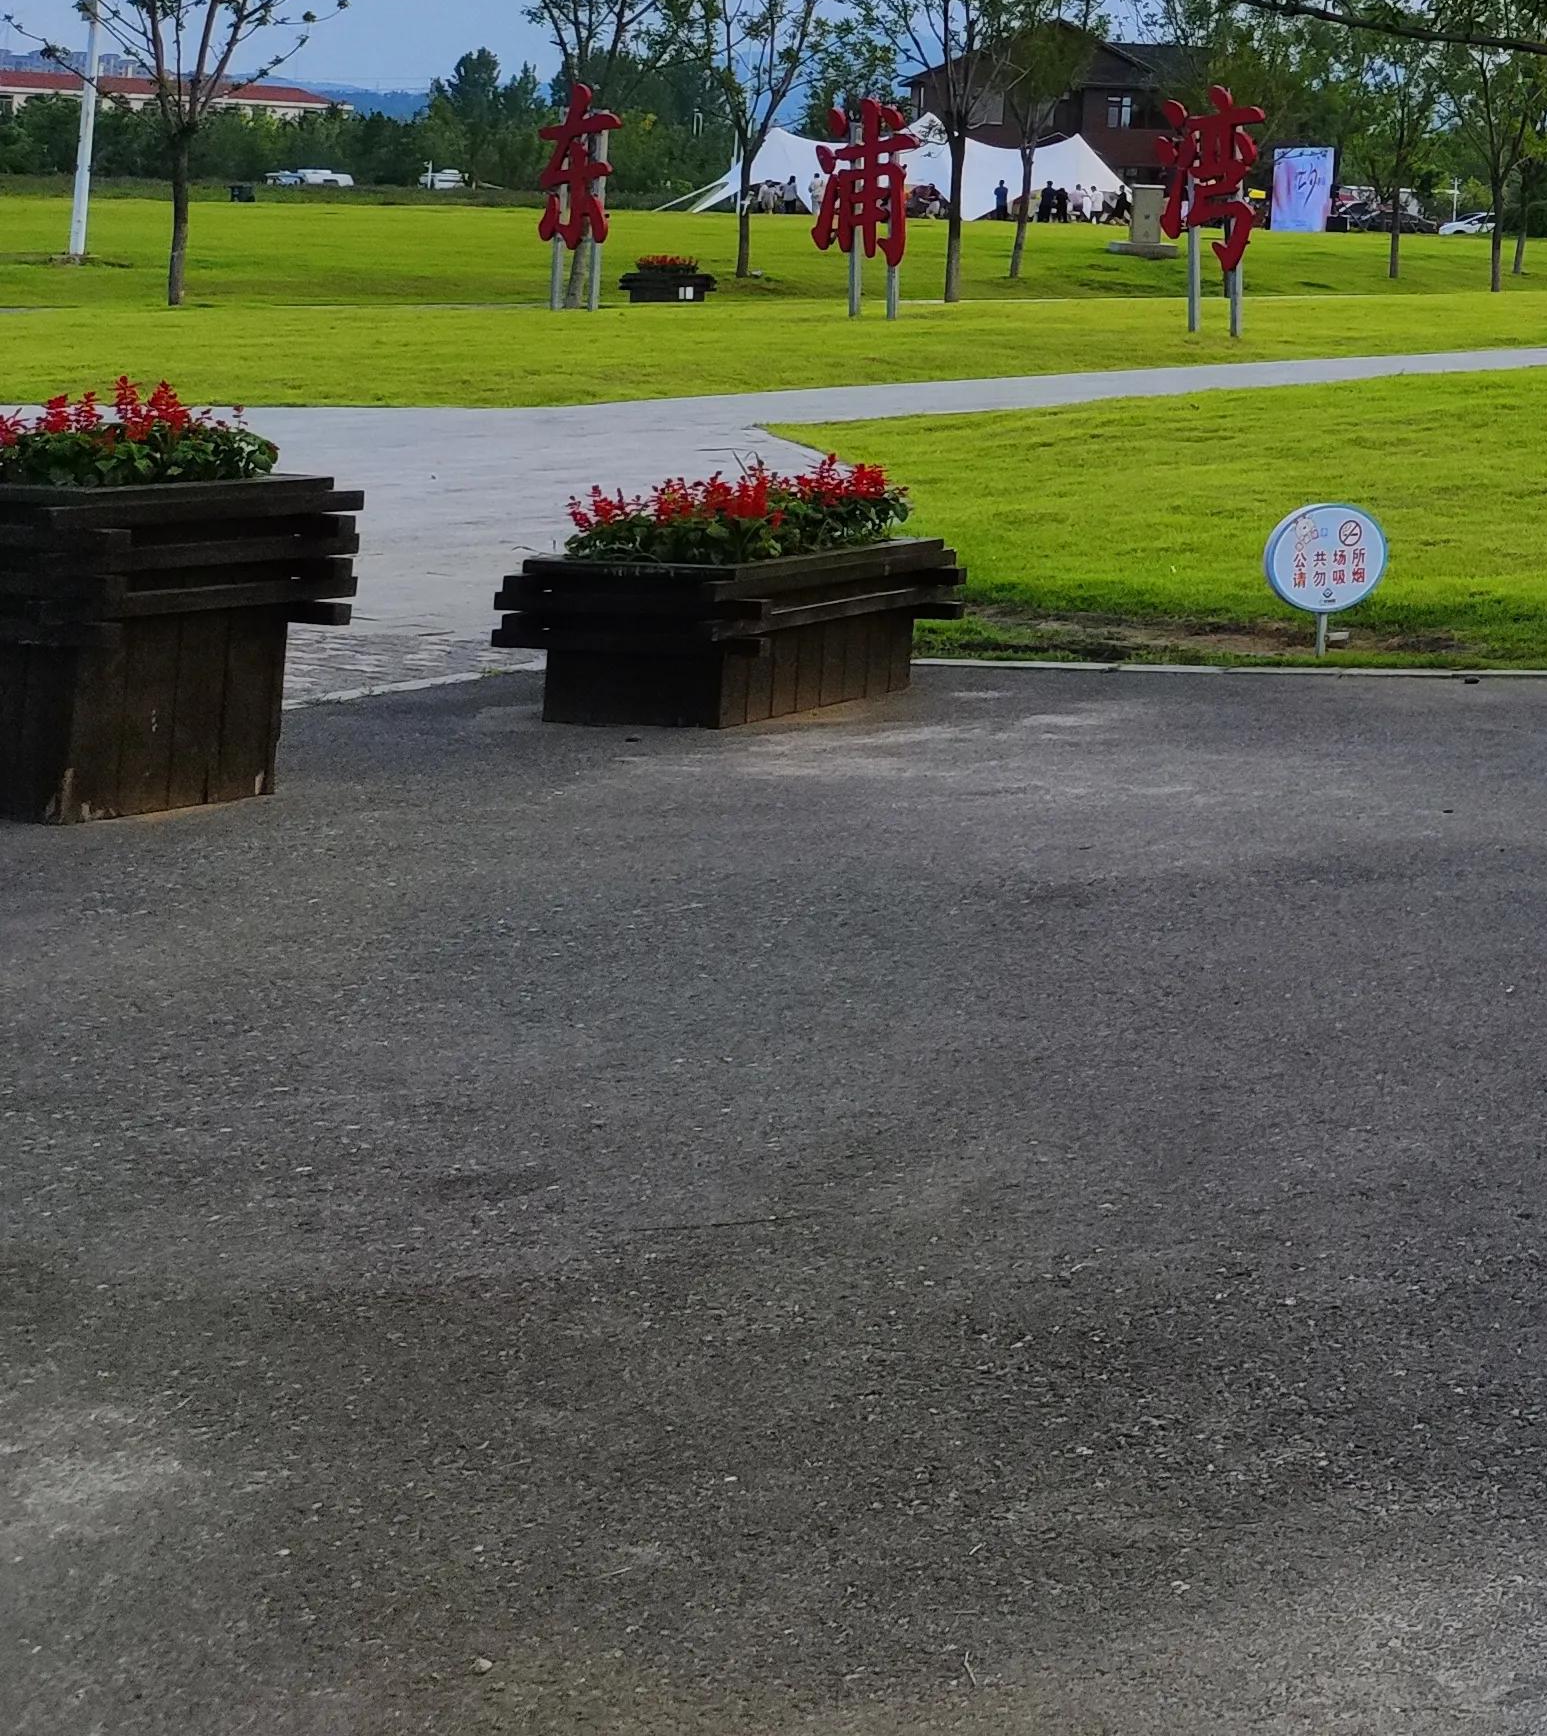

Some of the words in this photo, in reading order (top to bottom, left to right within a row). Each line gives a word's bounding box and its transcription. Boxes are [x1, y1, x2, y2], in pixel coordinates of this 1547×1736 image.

[811, 97, 920, 268] 浦
[1153, 84, 1267, 272] 湾
[1293, 548, 1366, 569] 公共场所
[1293, 567, 1366, 589] 请勿吸烟
